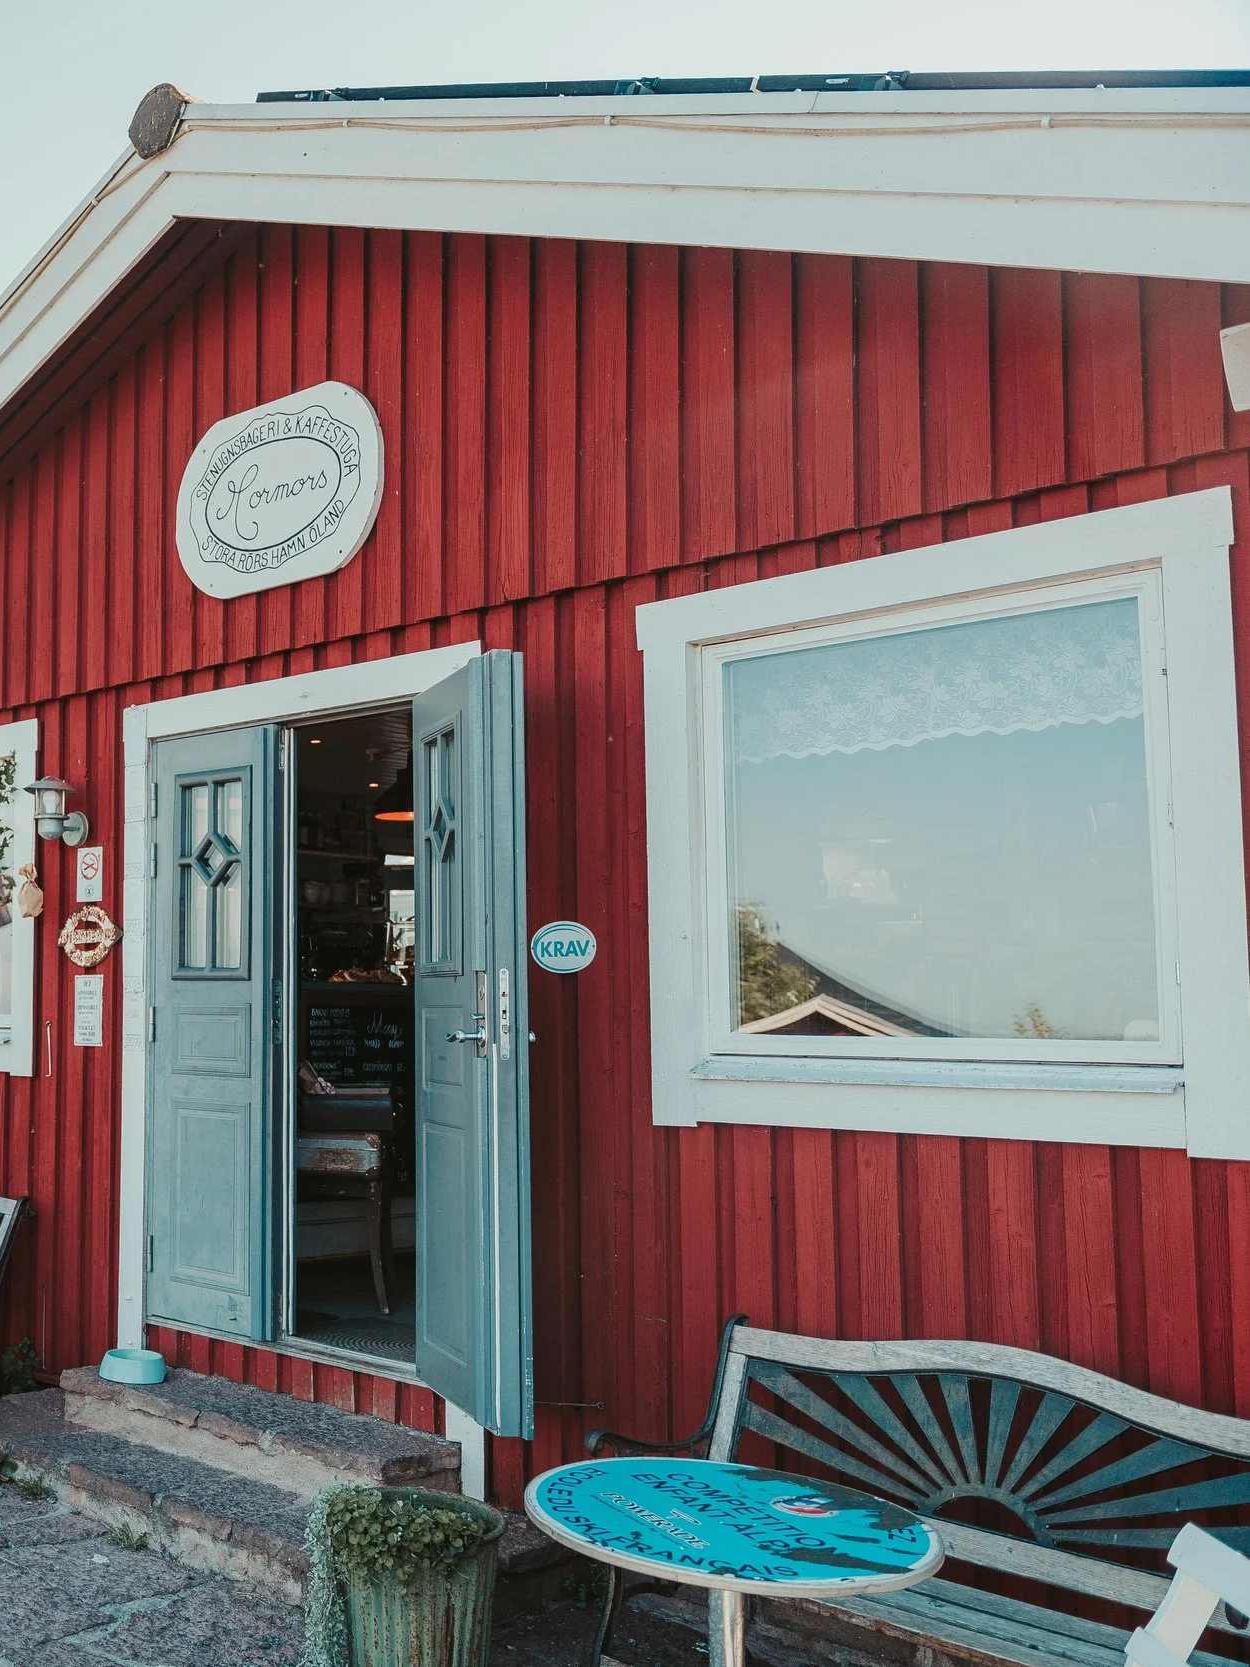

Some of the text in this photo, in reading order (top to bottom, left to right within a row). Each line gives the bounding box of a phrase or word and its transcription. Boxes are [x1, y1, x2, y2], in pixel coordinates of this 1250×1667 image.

[196, 415, 359, 501] STENUGNSBAGERI & KAFFESTUGA
[201, 499, 346, 571] STORA RÖRS HAMN ÖLAND
[125, 921, 141, 933] 2017
[540, 939, 591, 958] KRAV
[125, 1037, 142, 1048] 2019
[547, 1497, 576, 1513] DU
[564, 1516, 611, 1536] SKI
[631, 1473, 738, 1520] ENFANT
[667, 1473, 837, 1551] COMPETITIO
[600, 1492, 711, 1550] POWERADE
